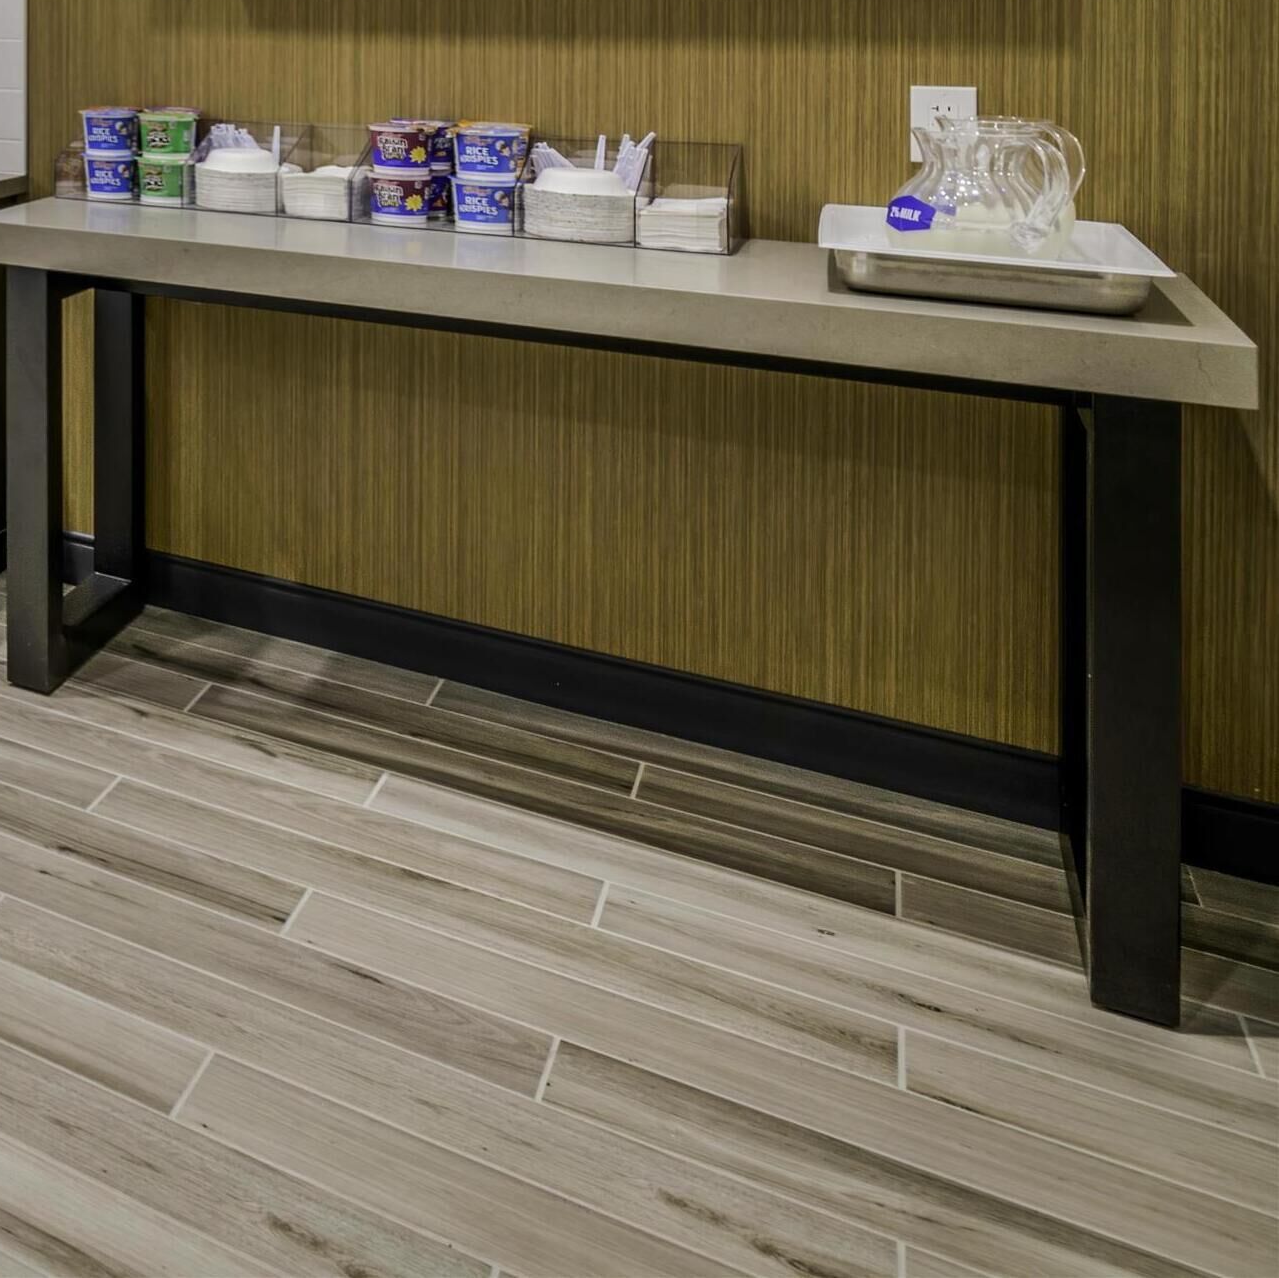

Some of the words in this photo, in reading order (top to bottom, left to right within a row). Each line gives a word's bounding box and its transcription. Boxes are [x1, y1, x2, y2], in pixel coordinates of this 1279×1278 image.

[92, 127, 111, 135] RICE
[465, 146, 489, 156] RICE
[460, 155, 499, 166] KRISPIES
[94, 170, 114, 178] RICE
[464, 196, 488, 205] RICE
[459, 204, 499, 215] KRISPIES
[900, 207, 922, 222] MILK
